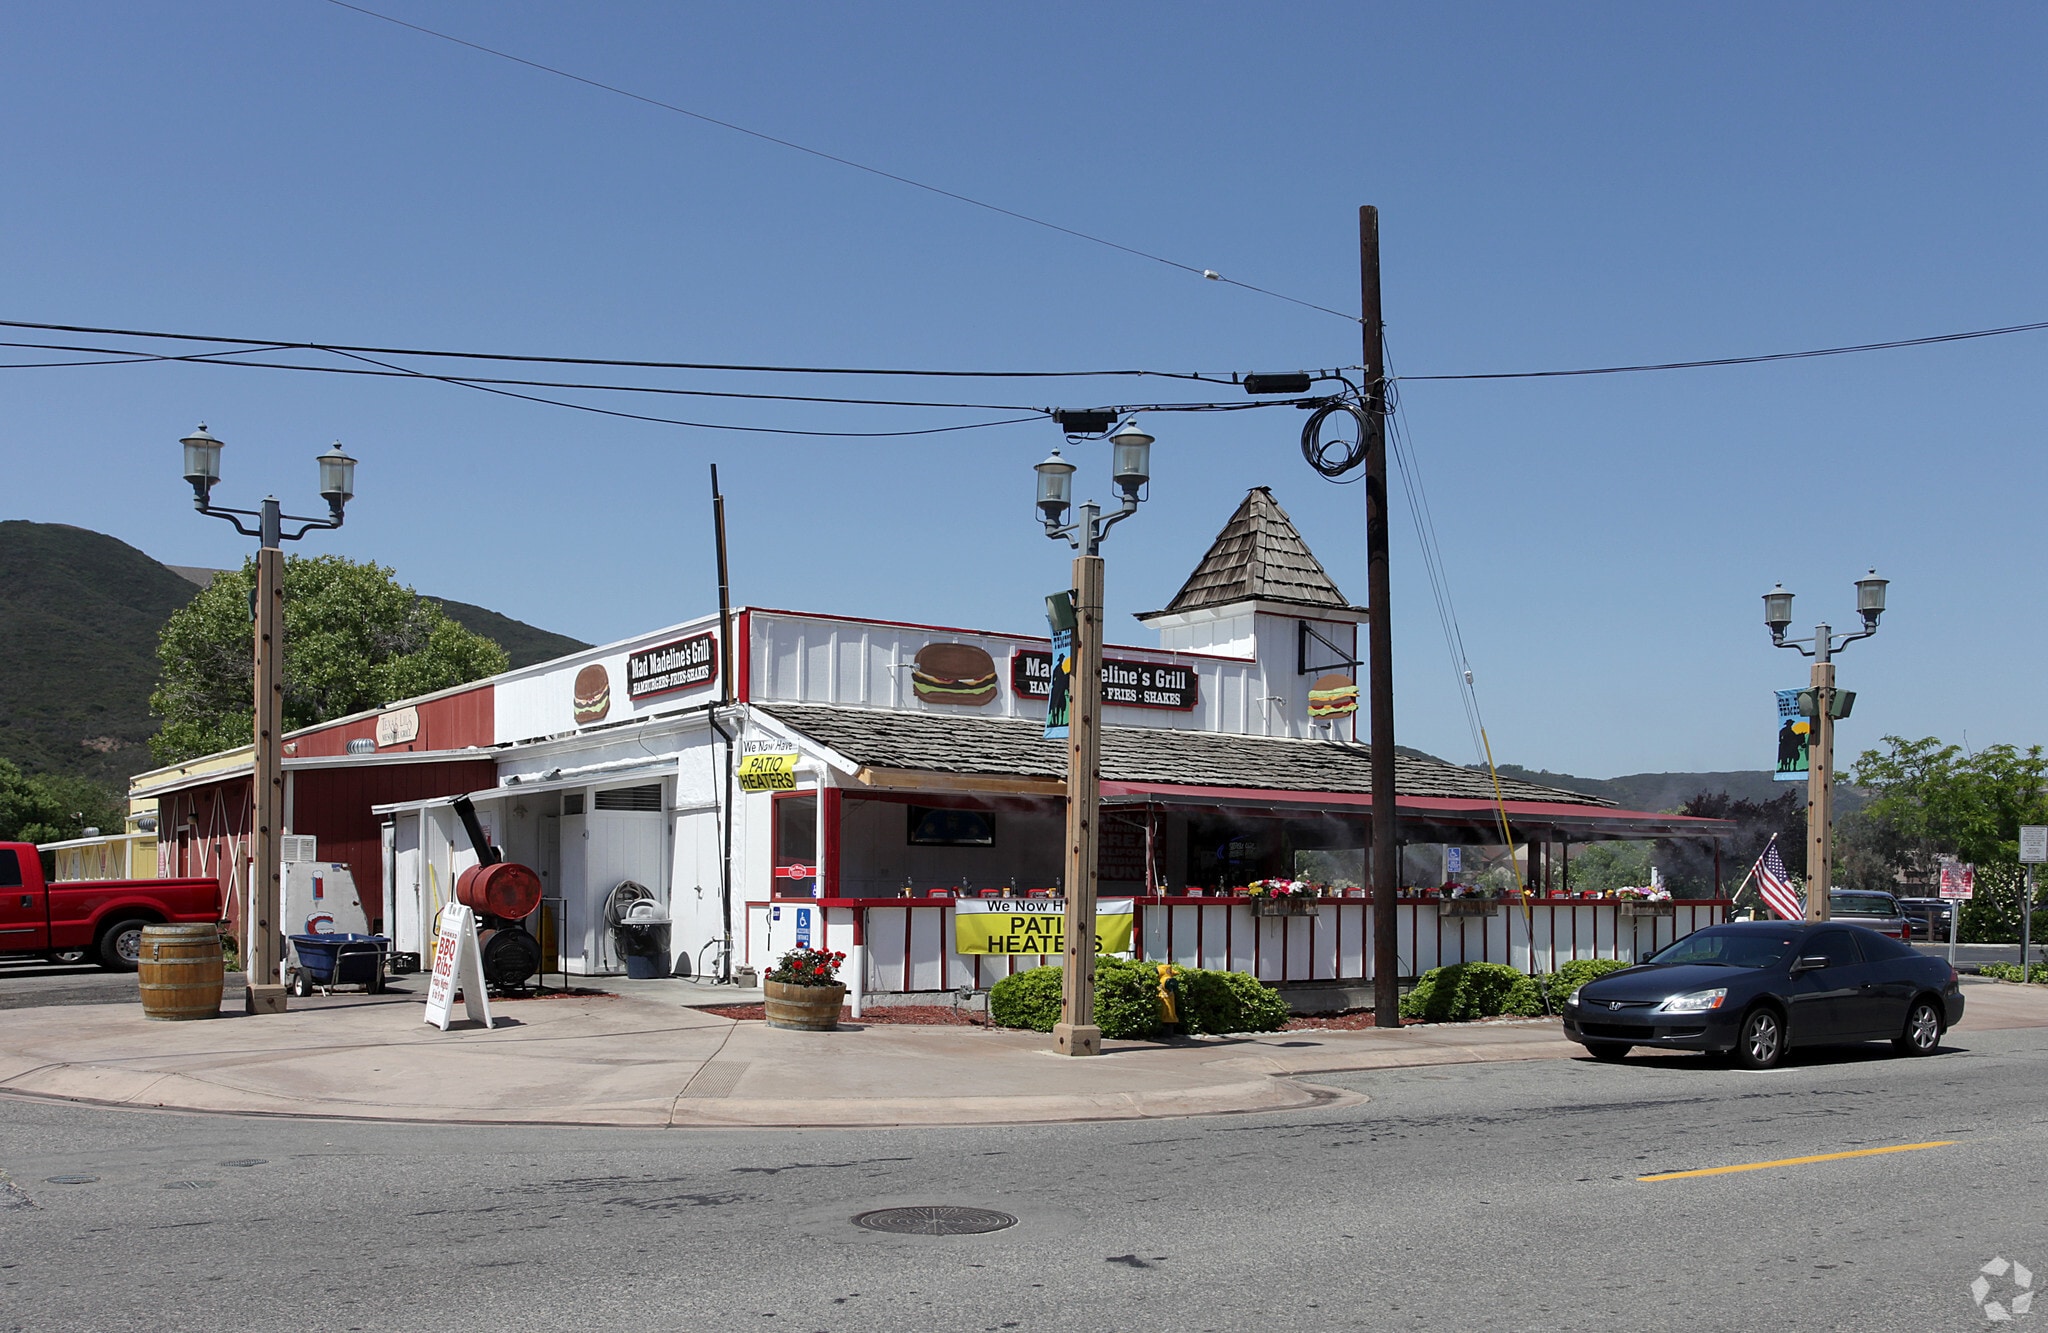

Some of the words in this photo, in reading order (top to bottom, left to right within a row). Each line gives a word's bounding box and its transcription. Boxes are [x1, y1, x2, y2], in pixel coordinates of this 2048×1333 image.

[631, 655, 649, 679] Mad
[649, 644, 691, 675] Madeline's
[691, 636, 710, 664] Grill
[1026, 657, 1051, 678] Ma
[1101, 665, 1151, 686] eline's
[1155, 669, 1186, 690] Grill
[1107, 687, 1137, 702] FRIES
[1143, 691, 1181, 706] SHAKES
[743, 741, 757, 753] We
[759, 740, 775, 752] Now
[749, 757, 783, 773] PATIO
[740, 772, 794, 790] HEATERS
[987, 900, 1010, 912] We
[1015, 900, 1048, 912] Now
[1011, 917, 1064, 935] PATI
[438, 937, 456, 962] BBQ
[988, 935, 1103, 953] HEATES
[434, 956, 452, 978] Ribs
